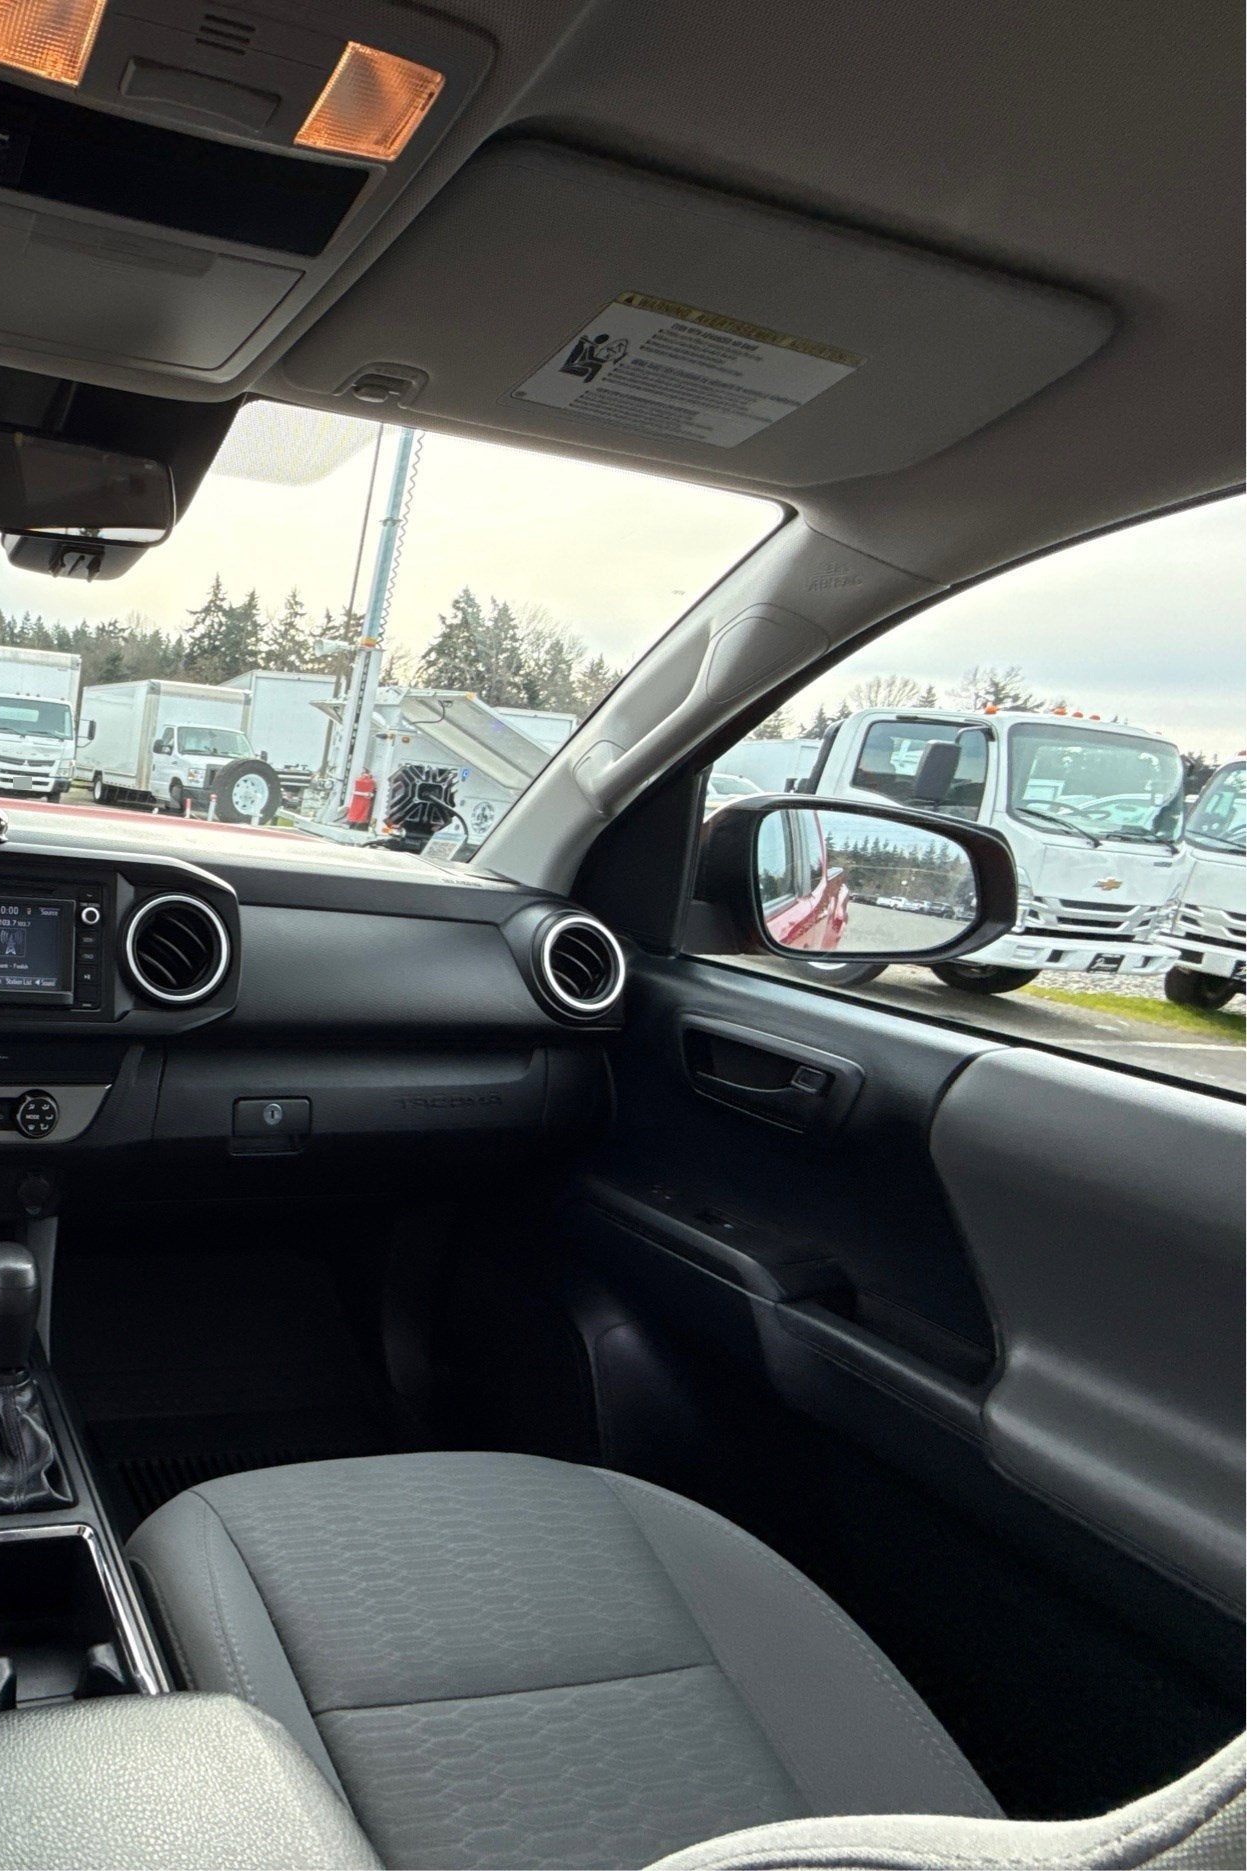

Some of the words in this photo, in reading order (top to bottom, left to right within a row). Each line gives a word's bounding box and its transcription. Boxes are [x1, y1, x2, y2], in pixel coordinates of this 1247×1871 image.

[41, 908, 59, 917] Source
[0, 919, 17, 927] 103.7
[26, 1113, 40, 1121] MODE
